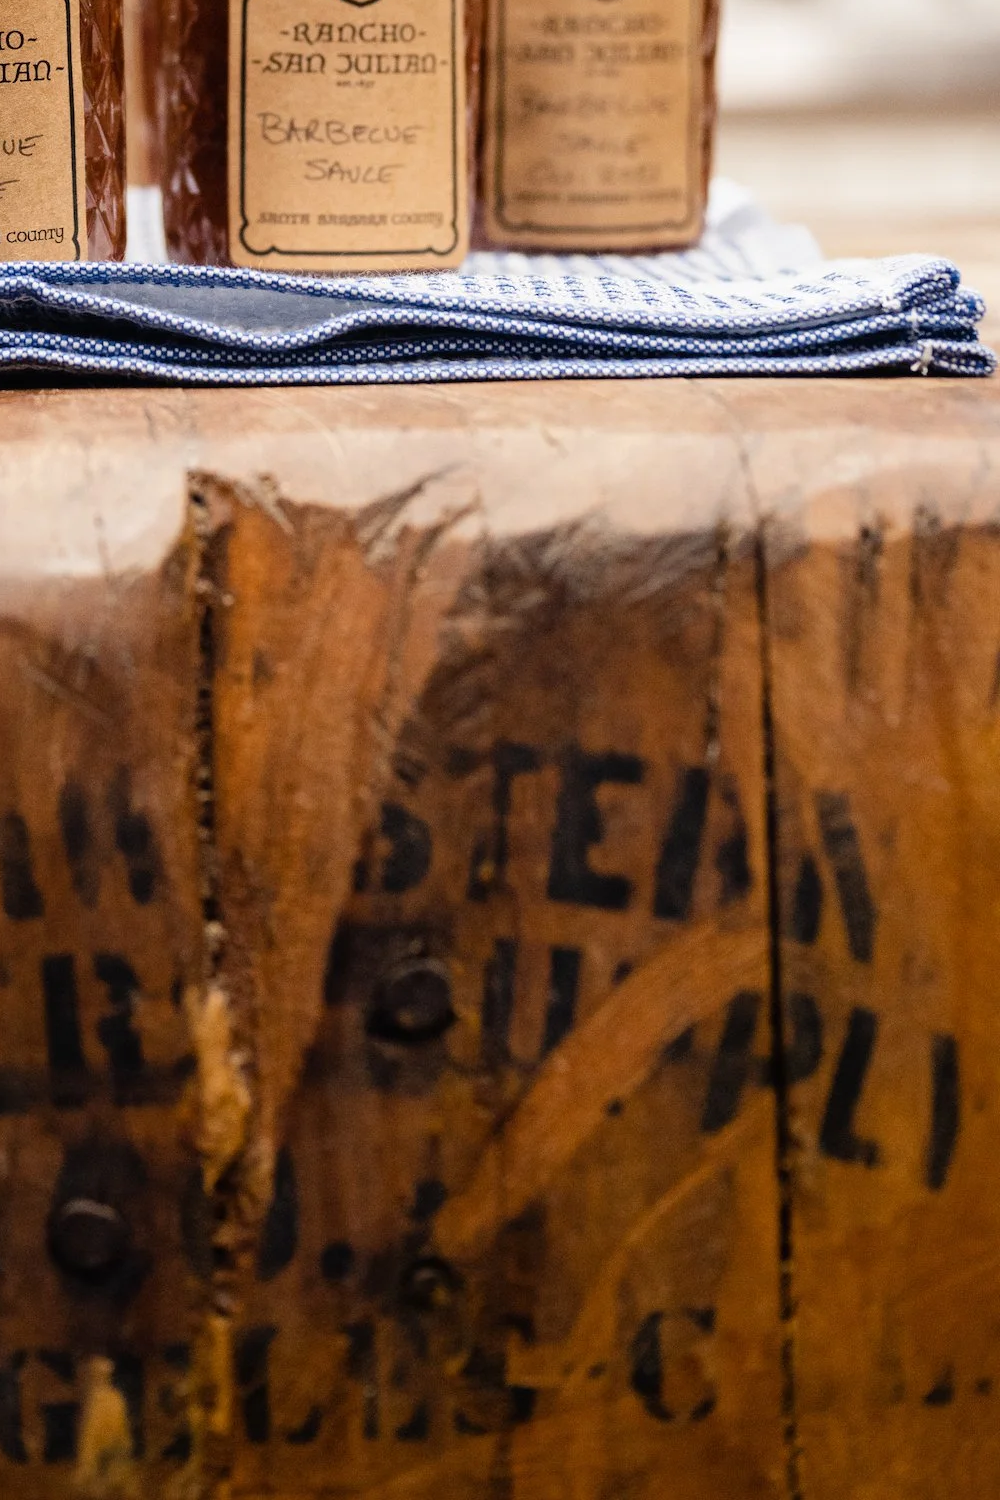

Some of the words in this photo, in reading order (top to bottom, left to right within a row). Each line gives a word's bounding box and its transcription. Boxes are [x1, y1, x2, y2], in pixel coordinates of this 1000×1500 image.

[257, 111, 428, 146] BARBECUE
[303, 158, 405, 185] SAUCE
[6, 226, 65, 244] COUNTY
